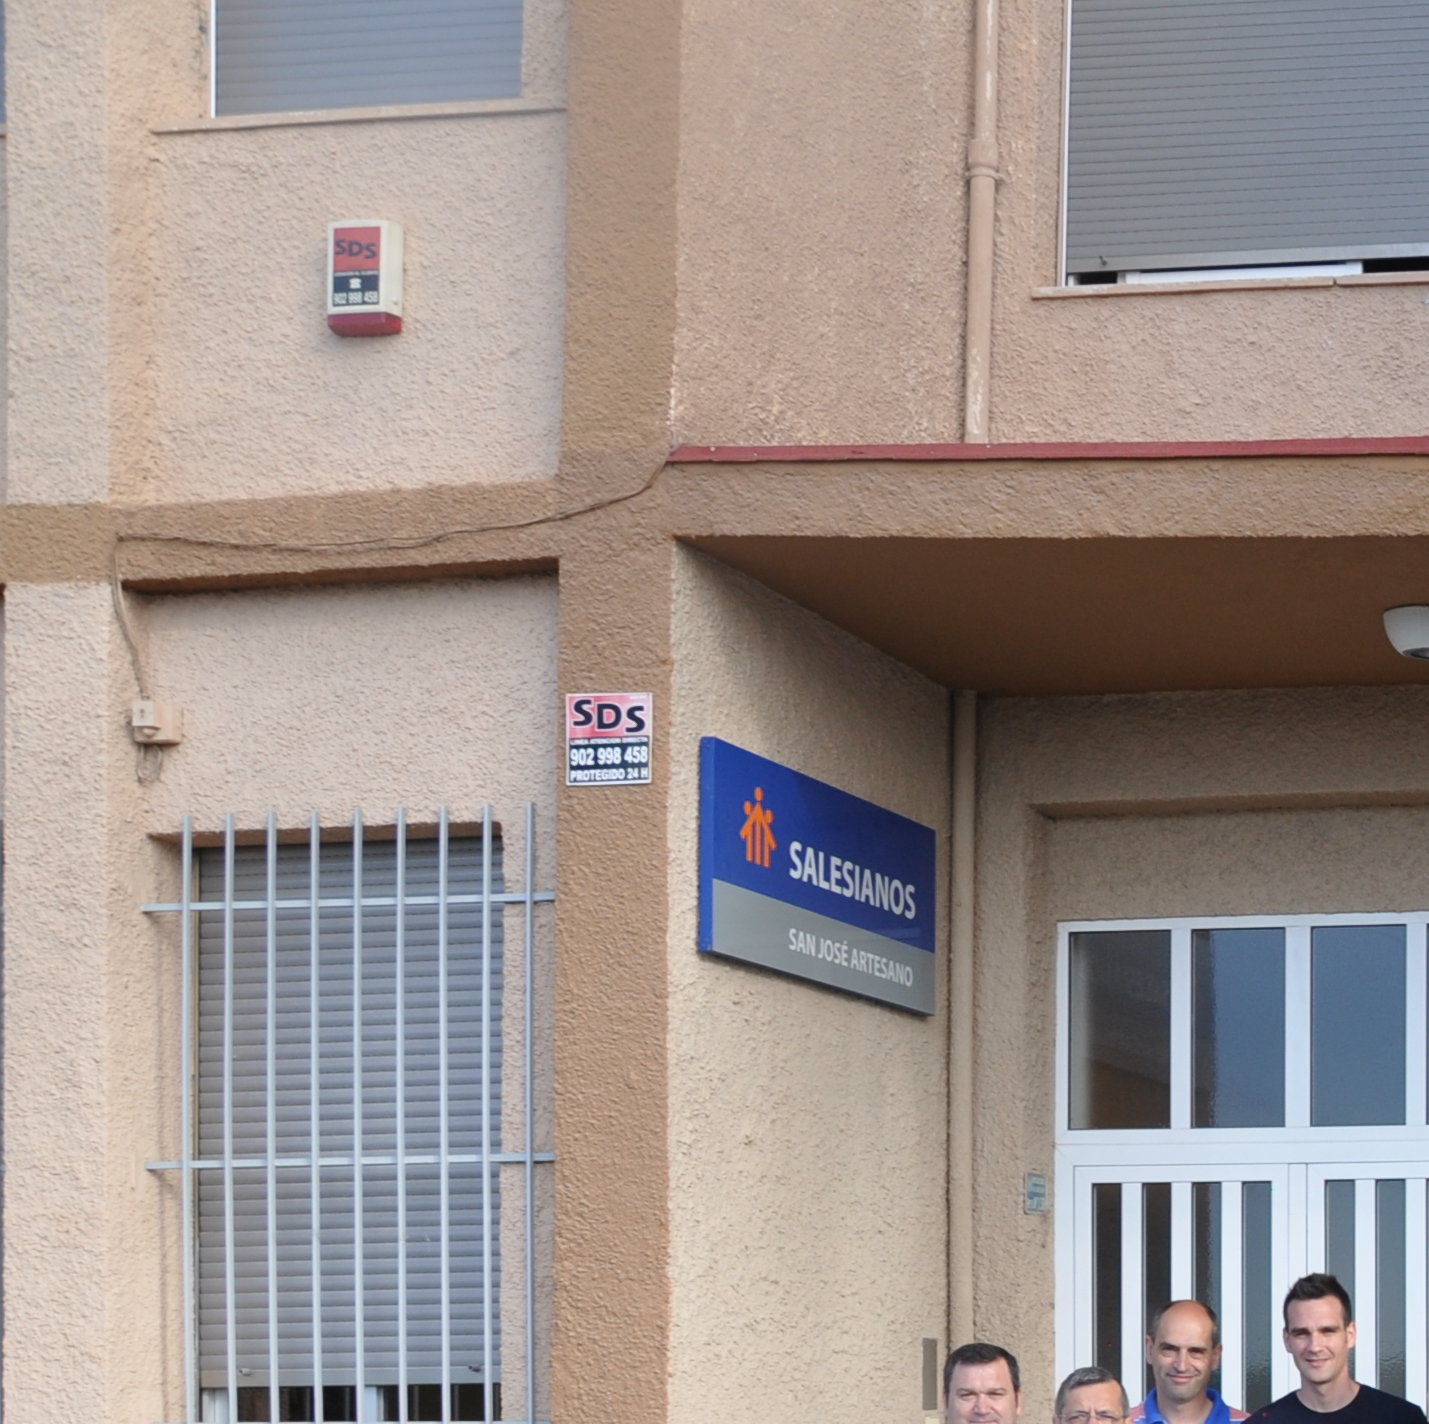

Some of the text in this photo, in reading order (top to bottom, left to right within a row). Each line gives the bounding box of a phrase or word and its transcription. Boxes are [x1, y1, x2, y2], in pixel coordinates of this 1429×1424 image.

[334, 238, 378, 259] SDS
[573, 699, 646, 733] SDS
[570, 745, 648, 766] 902 998 458
[570, 768, 625, 781] PROTEGIDO
[626, 767, 639, 779] 24
[789, 840, 916, 920] SALESIANOS
[788, 928, 914, 987] SAN JOSÉ ARTESANO
